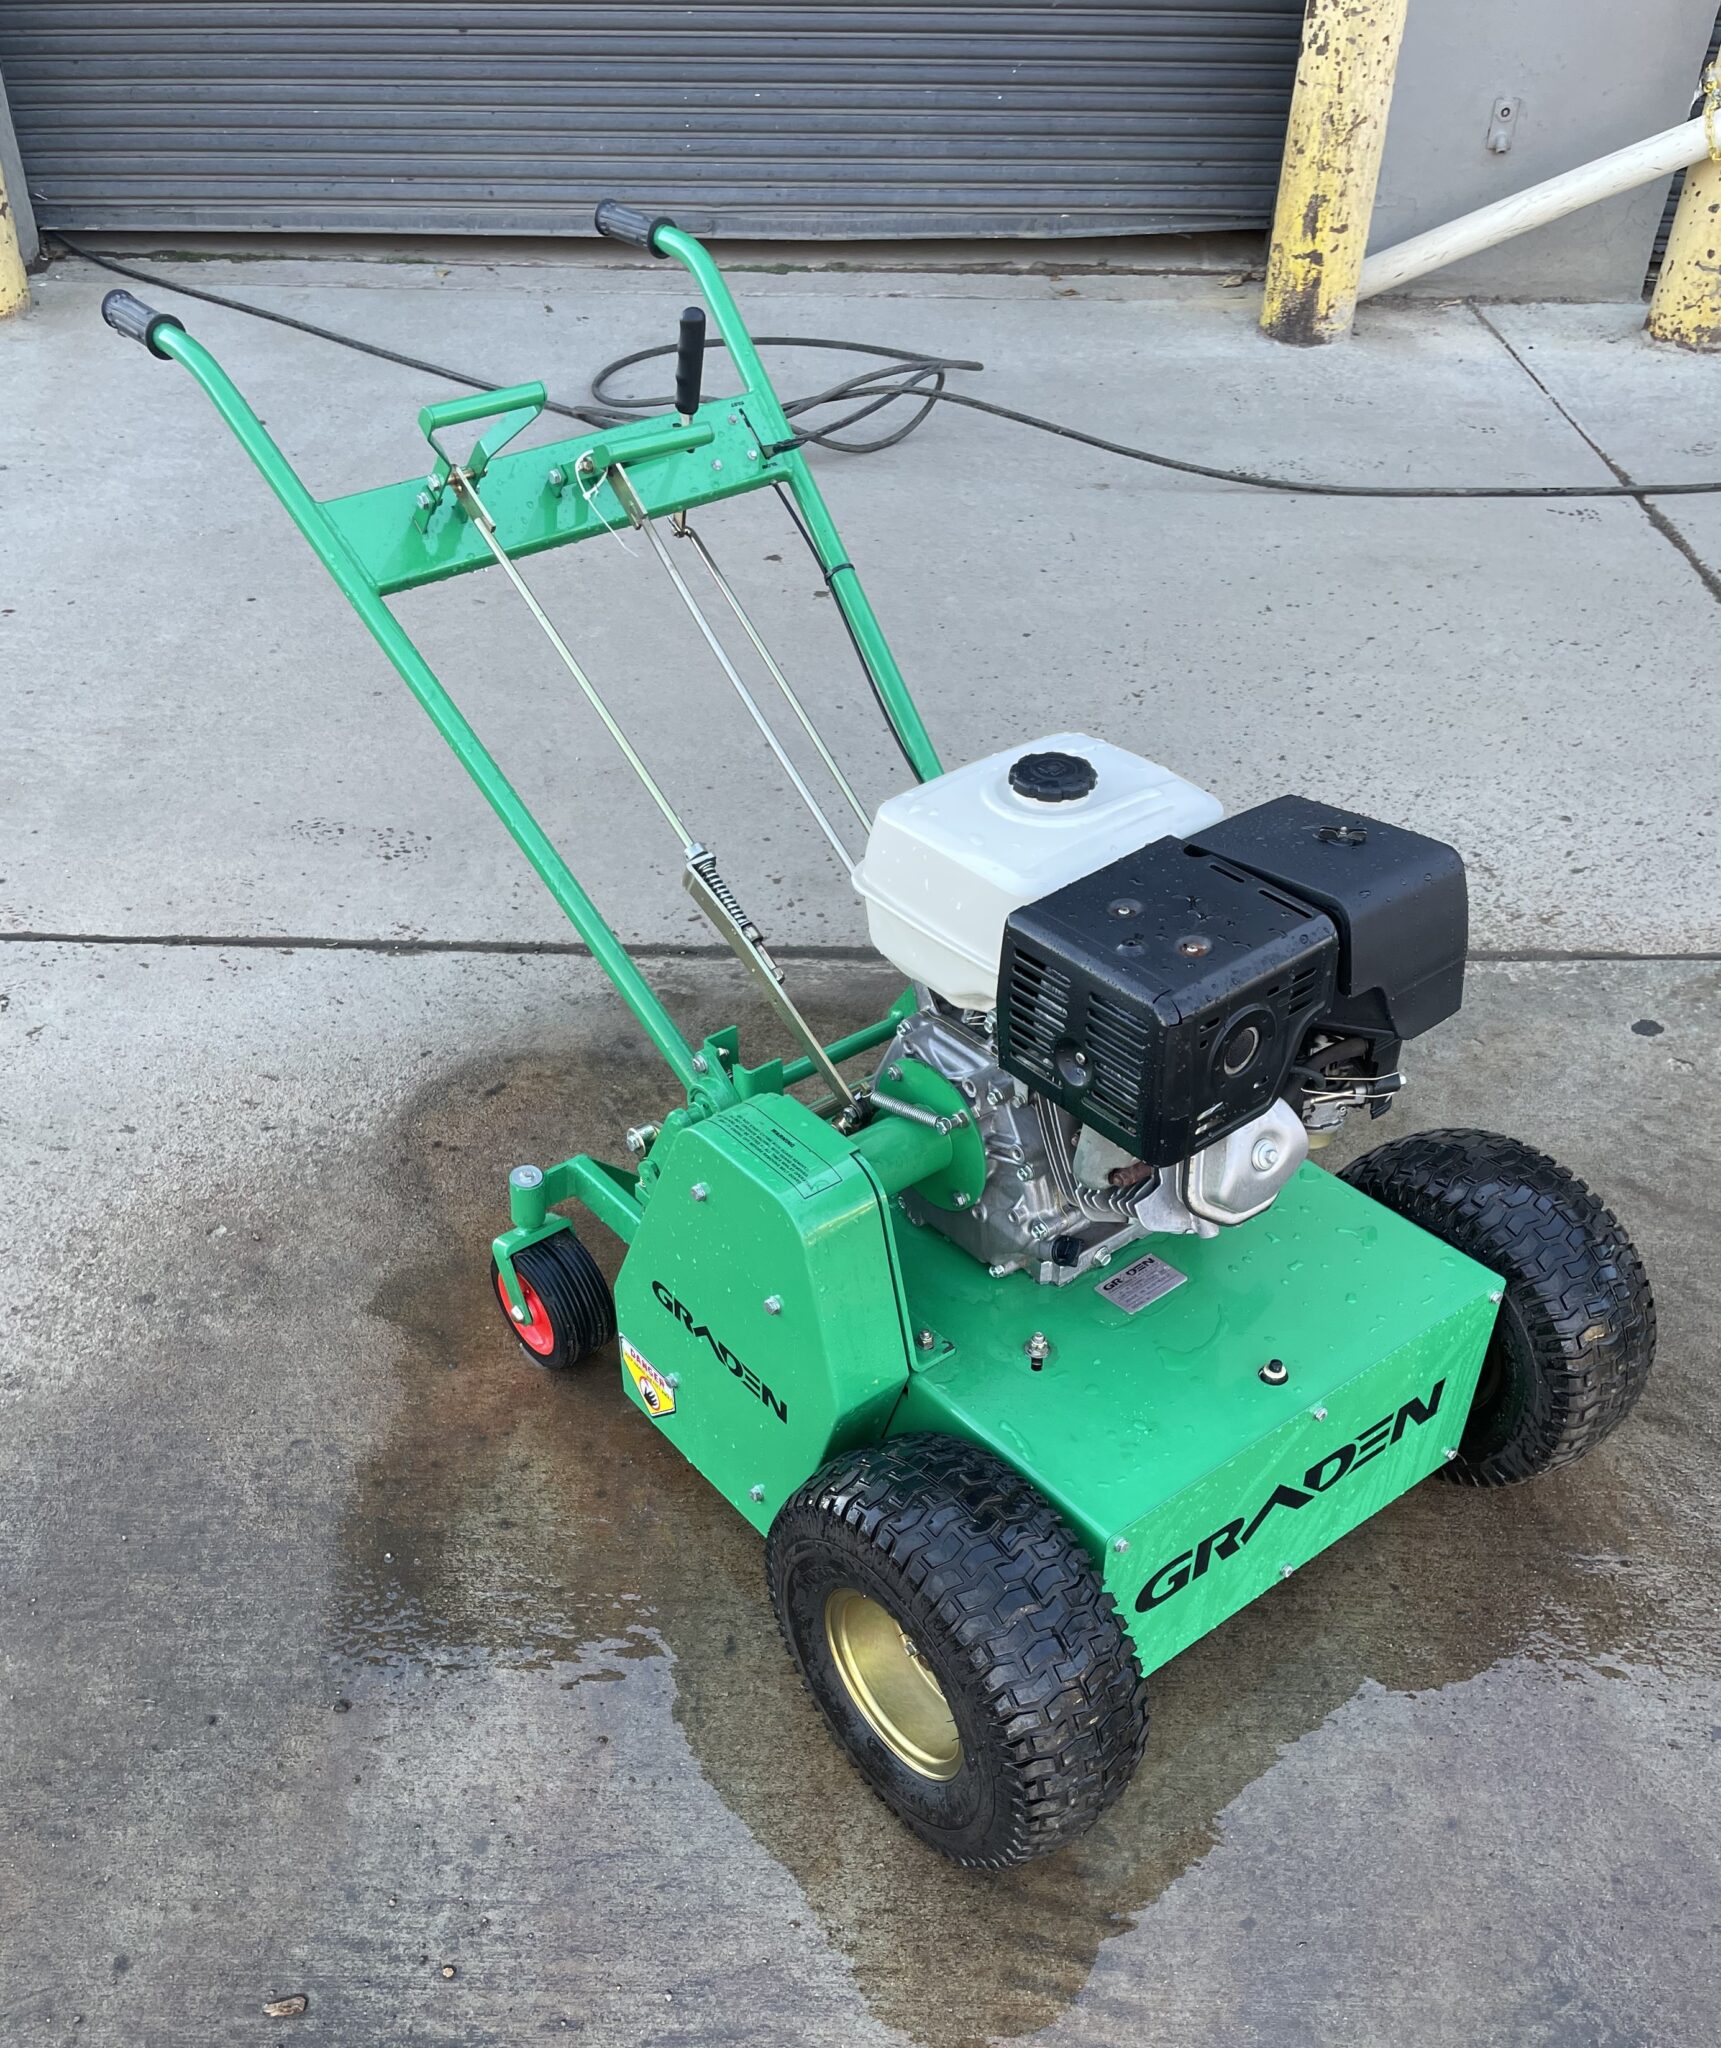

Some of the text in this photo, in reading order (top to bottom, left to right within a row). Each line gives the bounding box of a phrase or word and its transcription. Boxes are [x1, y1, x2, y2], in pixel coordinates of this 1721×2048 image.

[1103, 1257, 1156, 1291] GRDEN
[630, 1348, 665, 1388] DANGER
[652, 1280, 788, 1425] GRADEN
[1135, 1378, 1447, 1613] GRADEN
